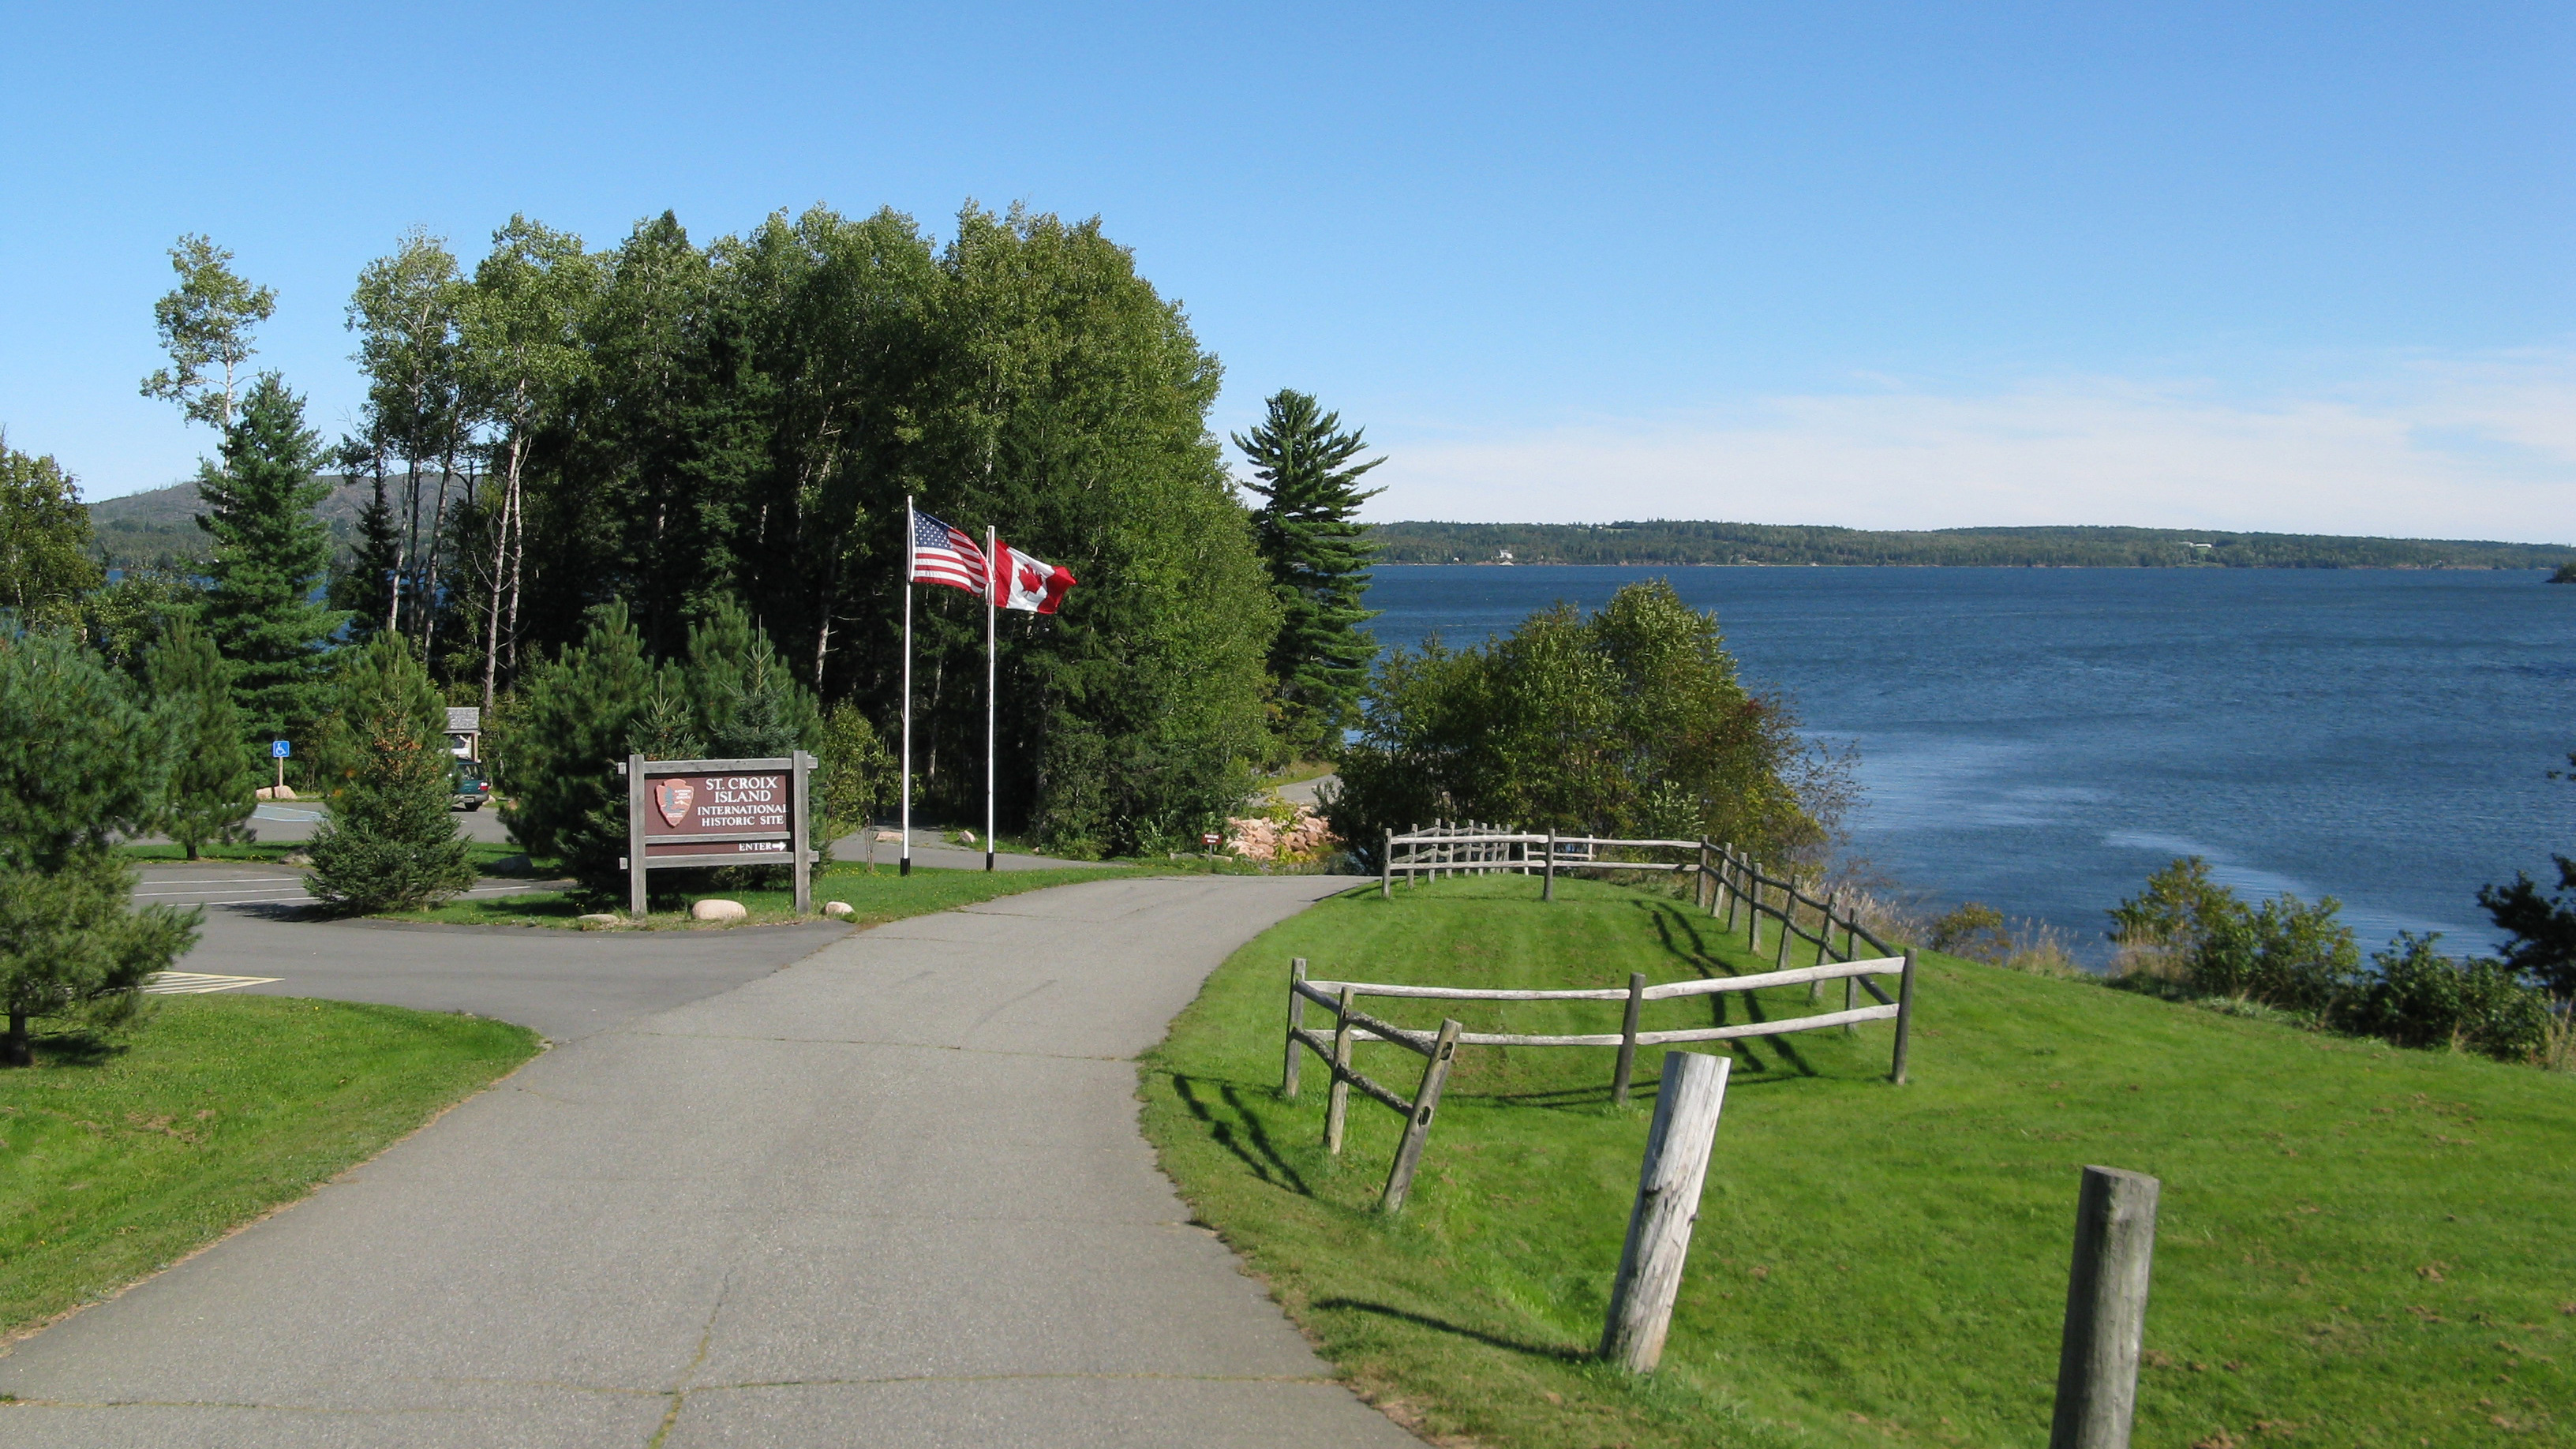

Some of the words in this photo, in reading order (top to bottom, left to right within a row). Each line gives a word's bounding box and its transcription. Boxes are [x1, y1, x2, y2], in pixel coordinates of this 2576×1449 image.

[706, 778, 724, 791] ST.
[728, 777, 778, 790] CROIX
[714, 789, 771, 803] ISLAND
[697, 803, 788, 816] INTERNATIONAL
[702, 816, 755, 827] HISTORIC
[759, 814, 784, 826] SITE
[739, 842, 773, 852] ENTER
